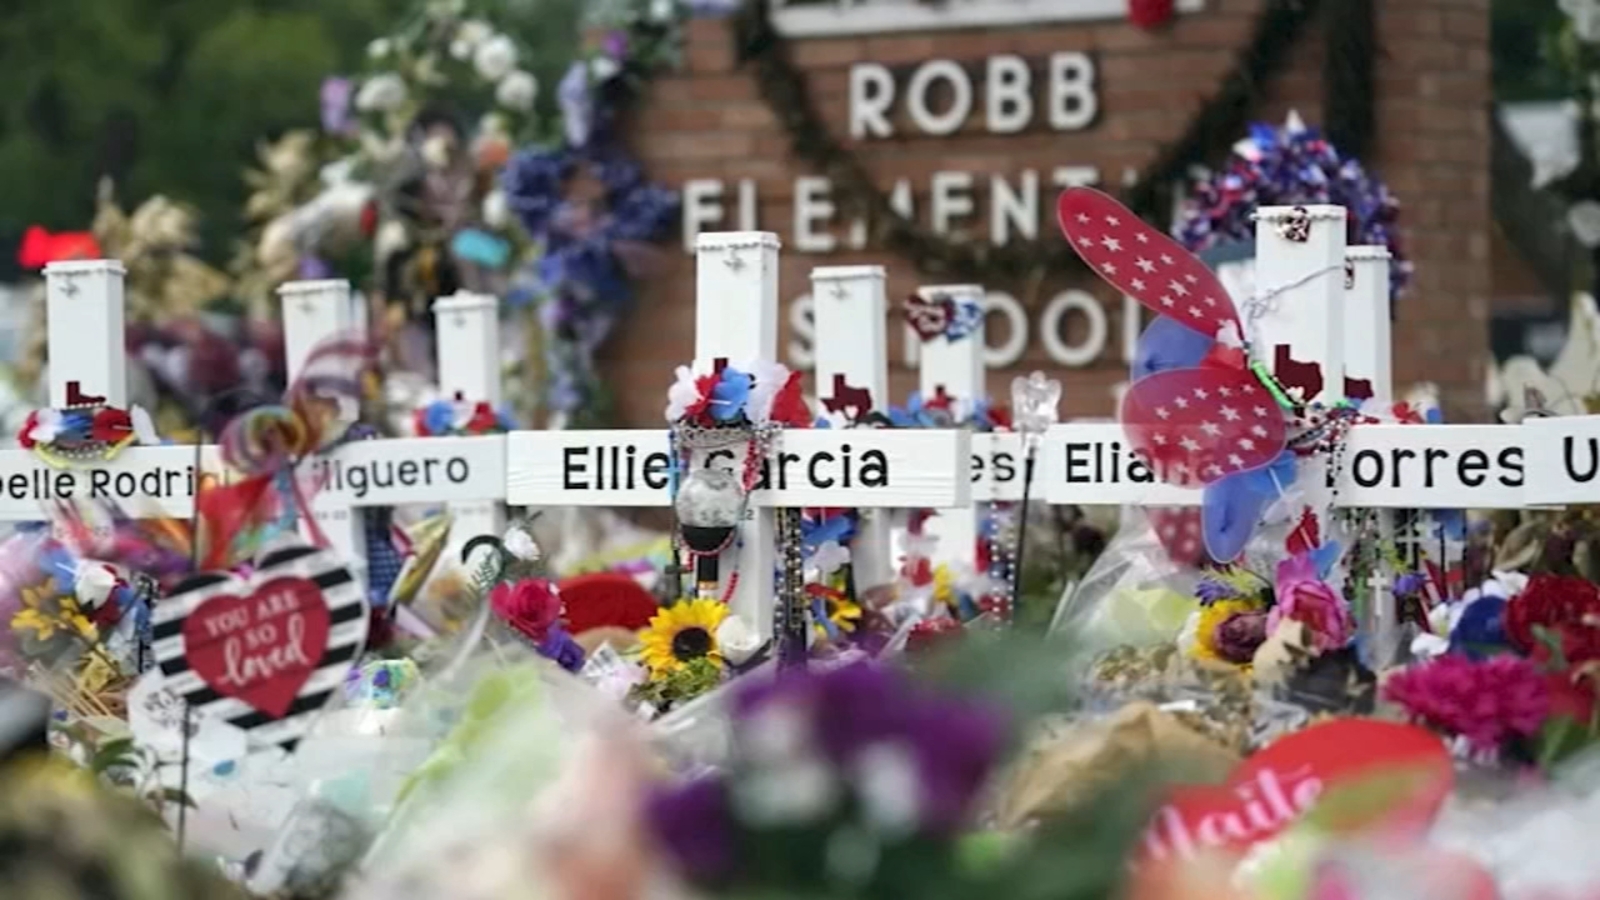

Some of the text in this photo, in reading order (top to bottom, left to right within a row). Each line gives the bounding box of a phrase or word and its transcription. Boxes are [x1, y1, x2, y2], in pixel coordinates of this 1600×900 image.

[849, 51, 1098, 139] ROBB
[787, 289, 1141, 368] SOOL
[0, 467, 76, 499] elle
[312, 456, 469, 497] ilguero
[563, 446, 672, 490] Ellie
[1326, 446, 1524, 488] orres
[204, 589, 299, 637] YOU ARE
[215, 610, 311, 686] loved
[245, 622, 278, 650] SO
